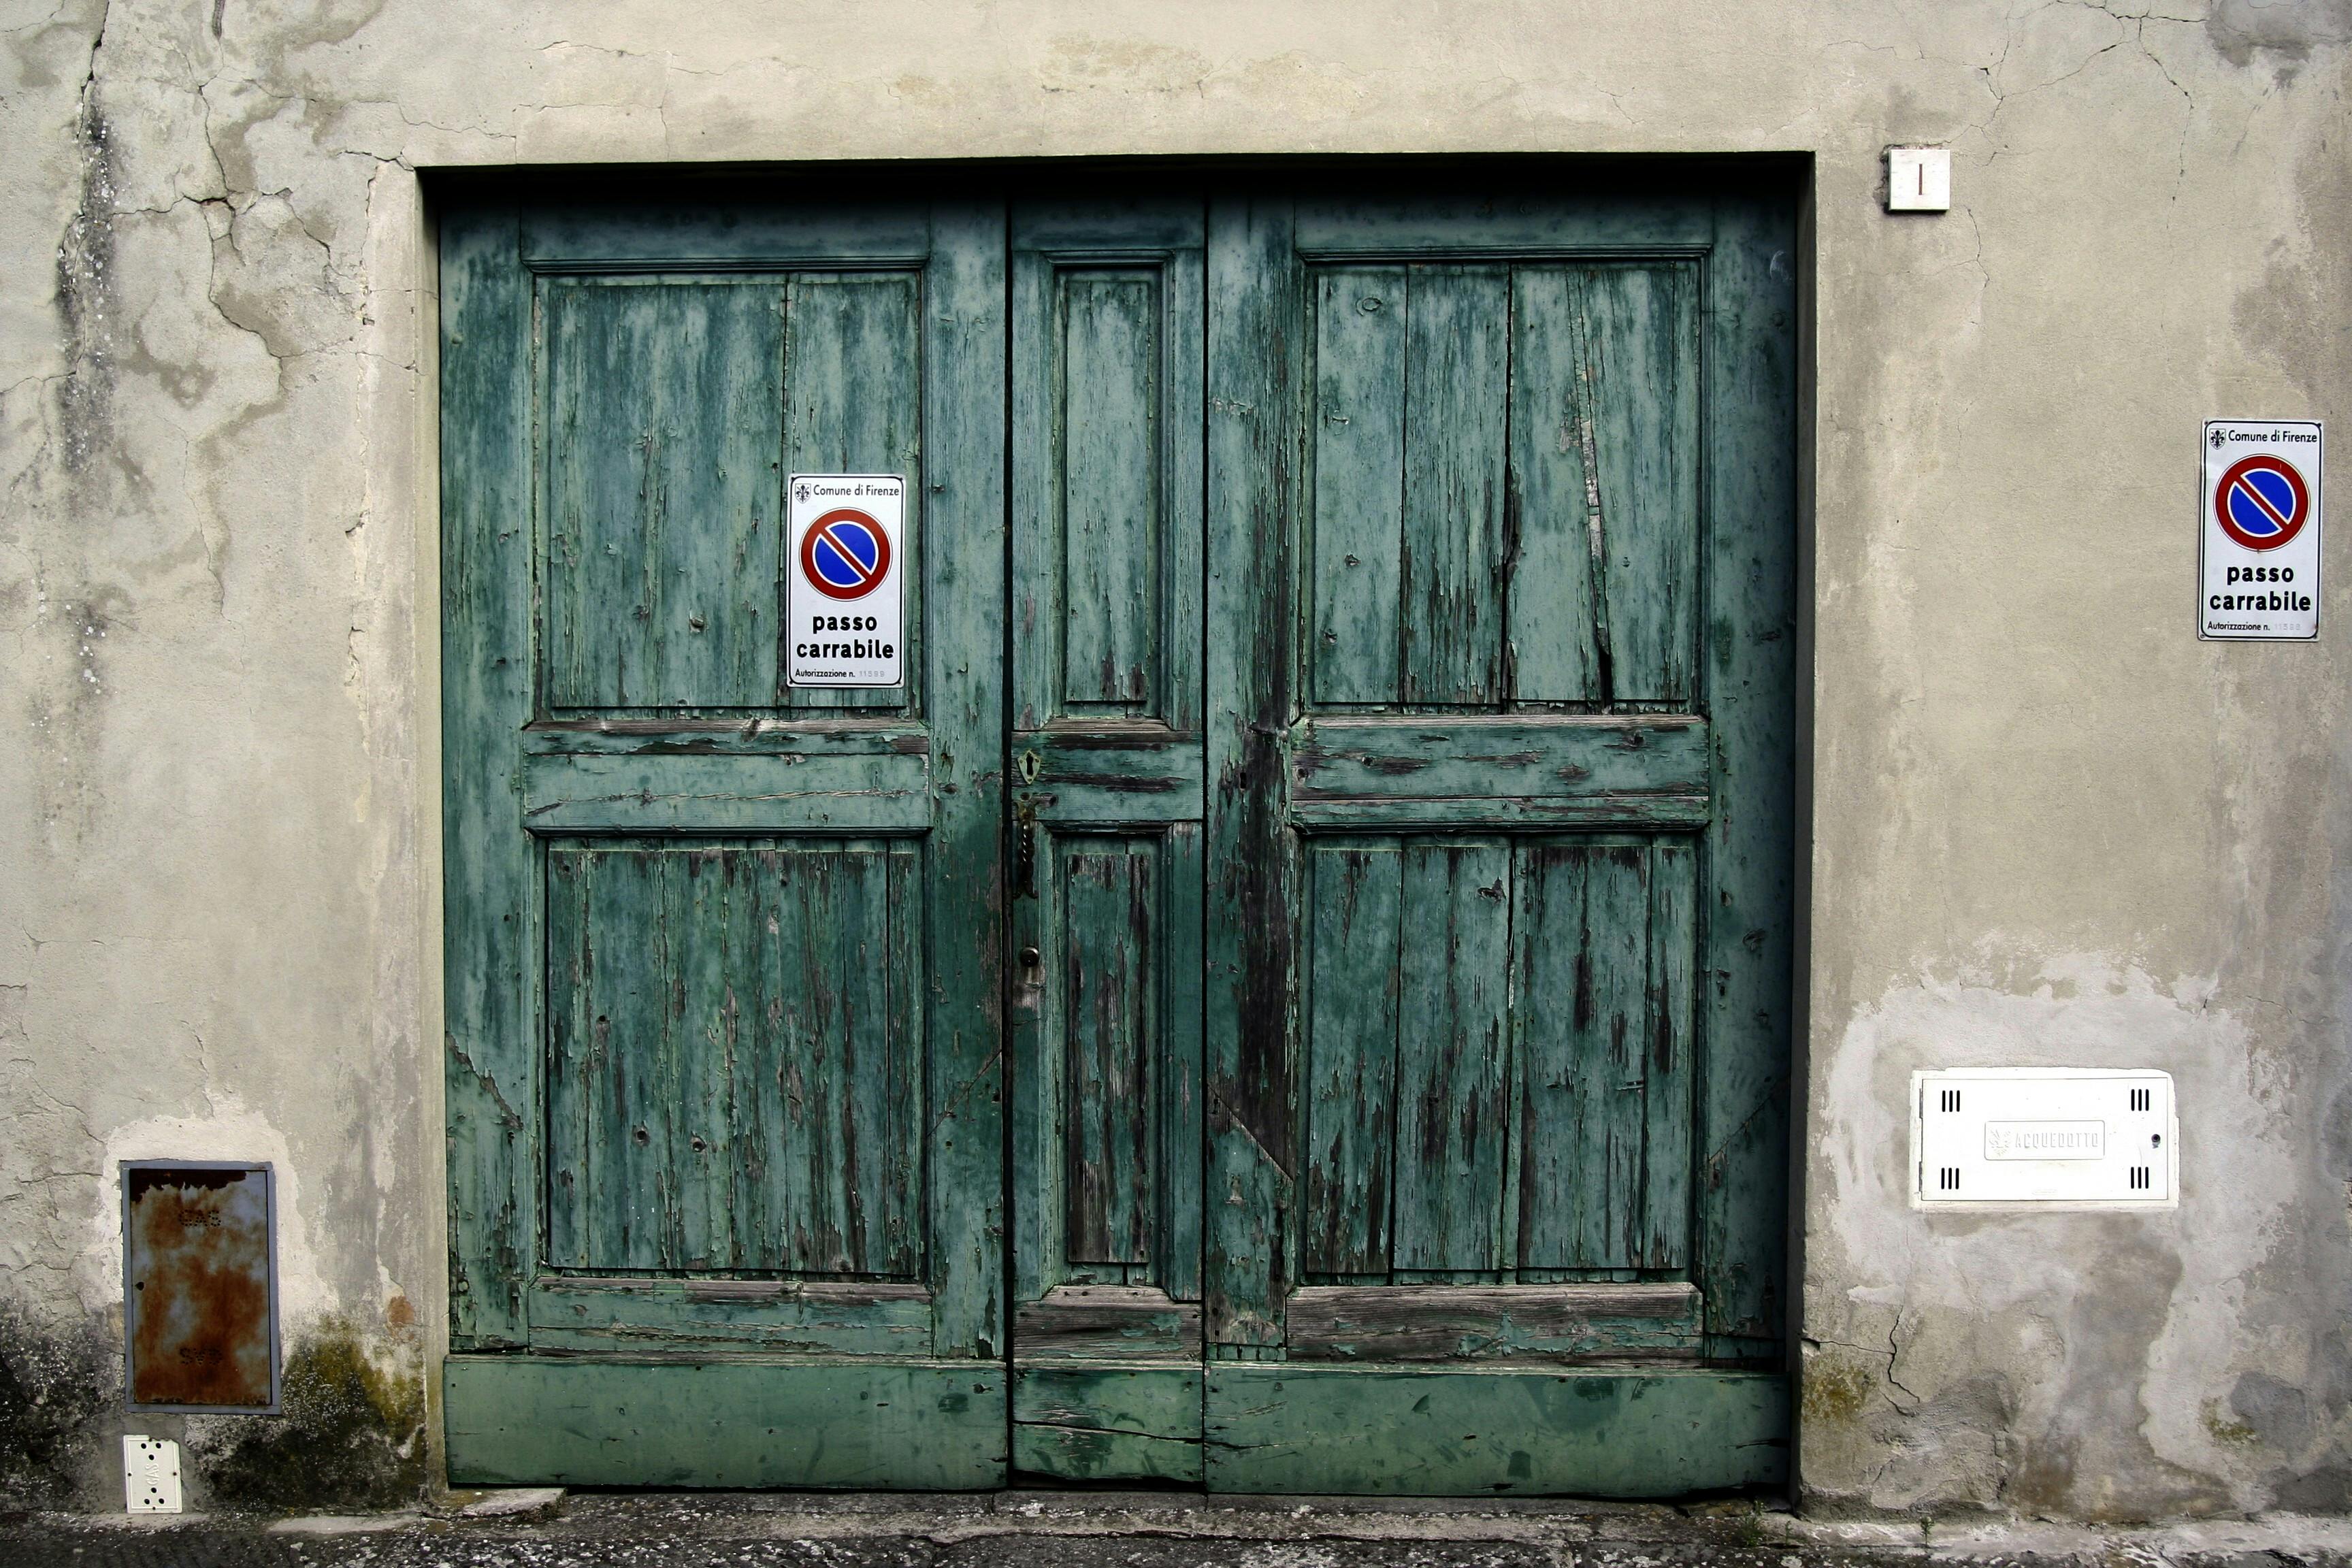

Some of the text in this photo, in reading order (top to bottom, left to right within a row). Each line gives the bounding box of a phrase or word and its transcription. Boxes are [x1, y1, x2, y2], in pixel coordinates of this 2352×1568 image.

[2228, 429, 2317, 443] Comune di Firenze
[813, 483, 900, 496] Comune di Firenze
[2227, 566, 2294, 586] passo
[2209, 591, 2311, 611] carrabile
[813, 615, 877, 634] passo
[2207, 621, 2261, 631] Autorizzazione
[796, 639, 894, 659] carrabile
[795, 668, 847, 678] Autorizzazione
[2014, 1132, 2099, 1149] ACQUEDOTTO
[178, 1209, 222, 1227] GAS
[144, 1463, 160, 1486] GAS
